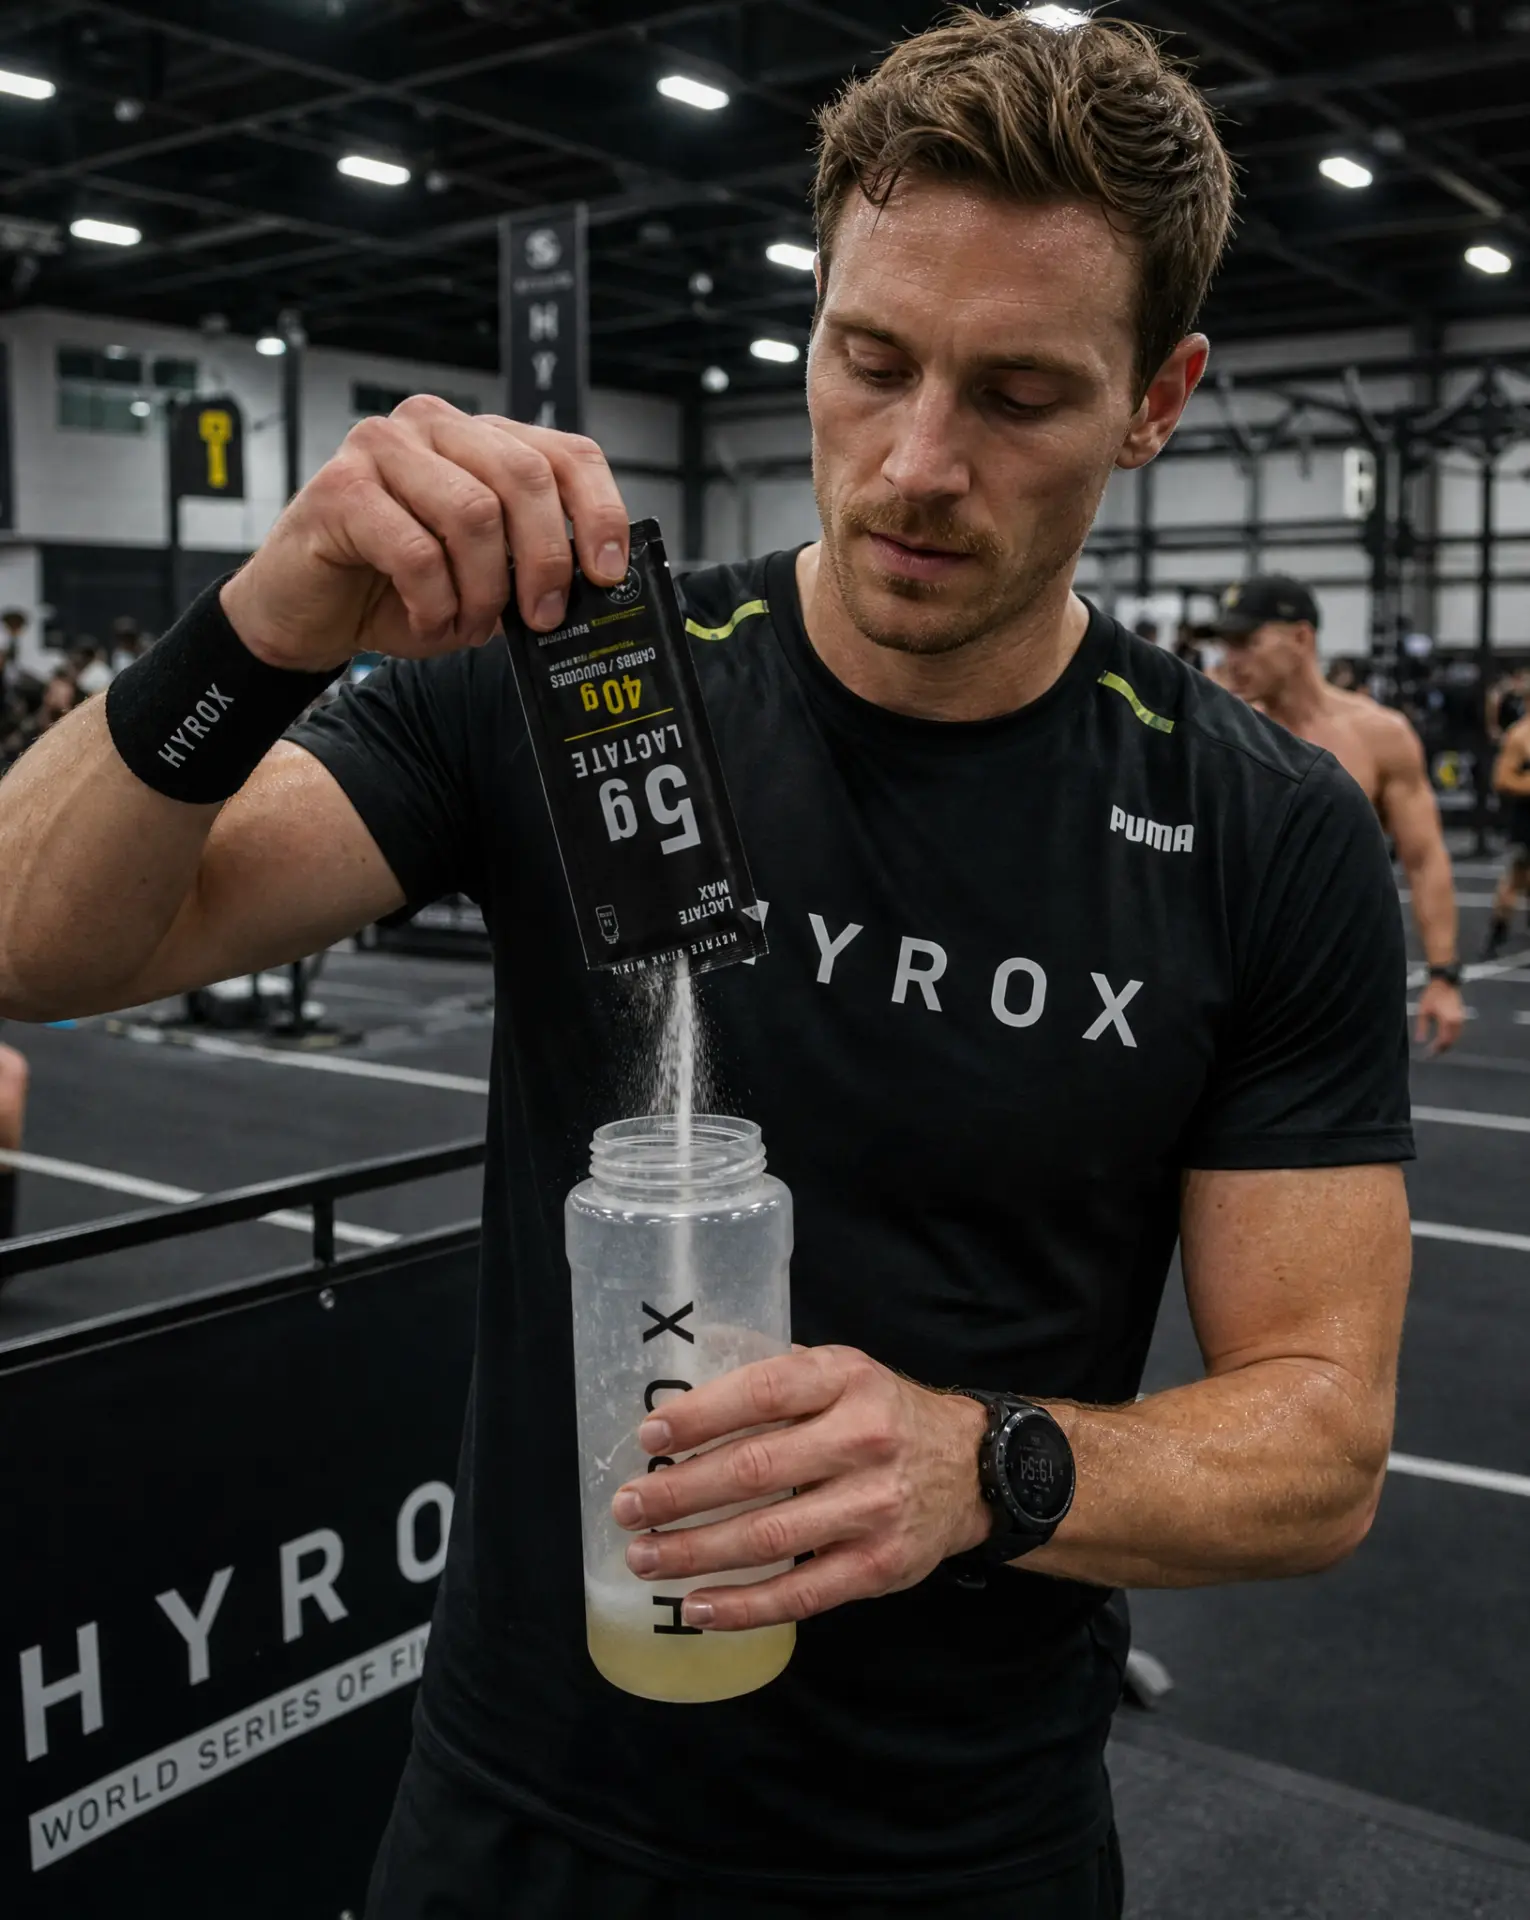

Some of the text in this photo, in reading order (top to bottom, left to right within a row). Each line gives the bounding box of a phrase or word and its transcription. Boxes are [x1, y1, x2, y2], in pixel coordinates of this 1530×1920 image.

[157, 682, 235, 769] HYROX
[571, 723, 683, 779] LACTATE
[1110, 804, 1194, 853] PUMA
[678, 896, 735, 926] LACTATE
[697, 878, 730, 901] MAX
[756, 900, 1144, 1048] YROX
[41, 1758, 179, 1850] WORLD
[199, 1689, 321, 1770] SERIES
[337, 1660, 377, 1703] OF
